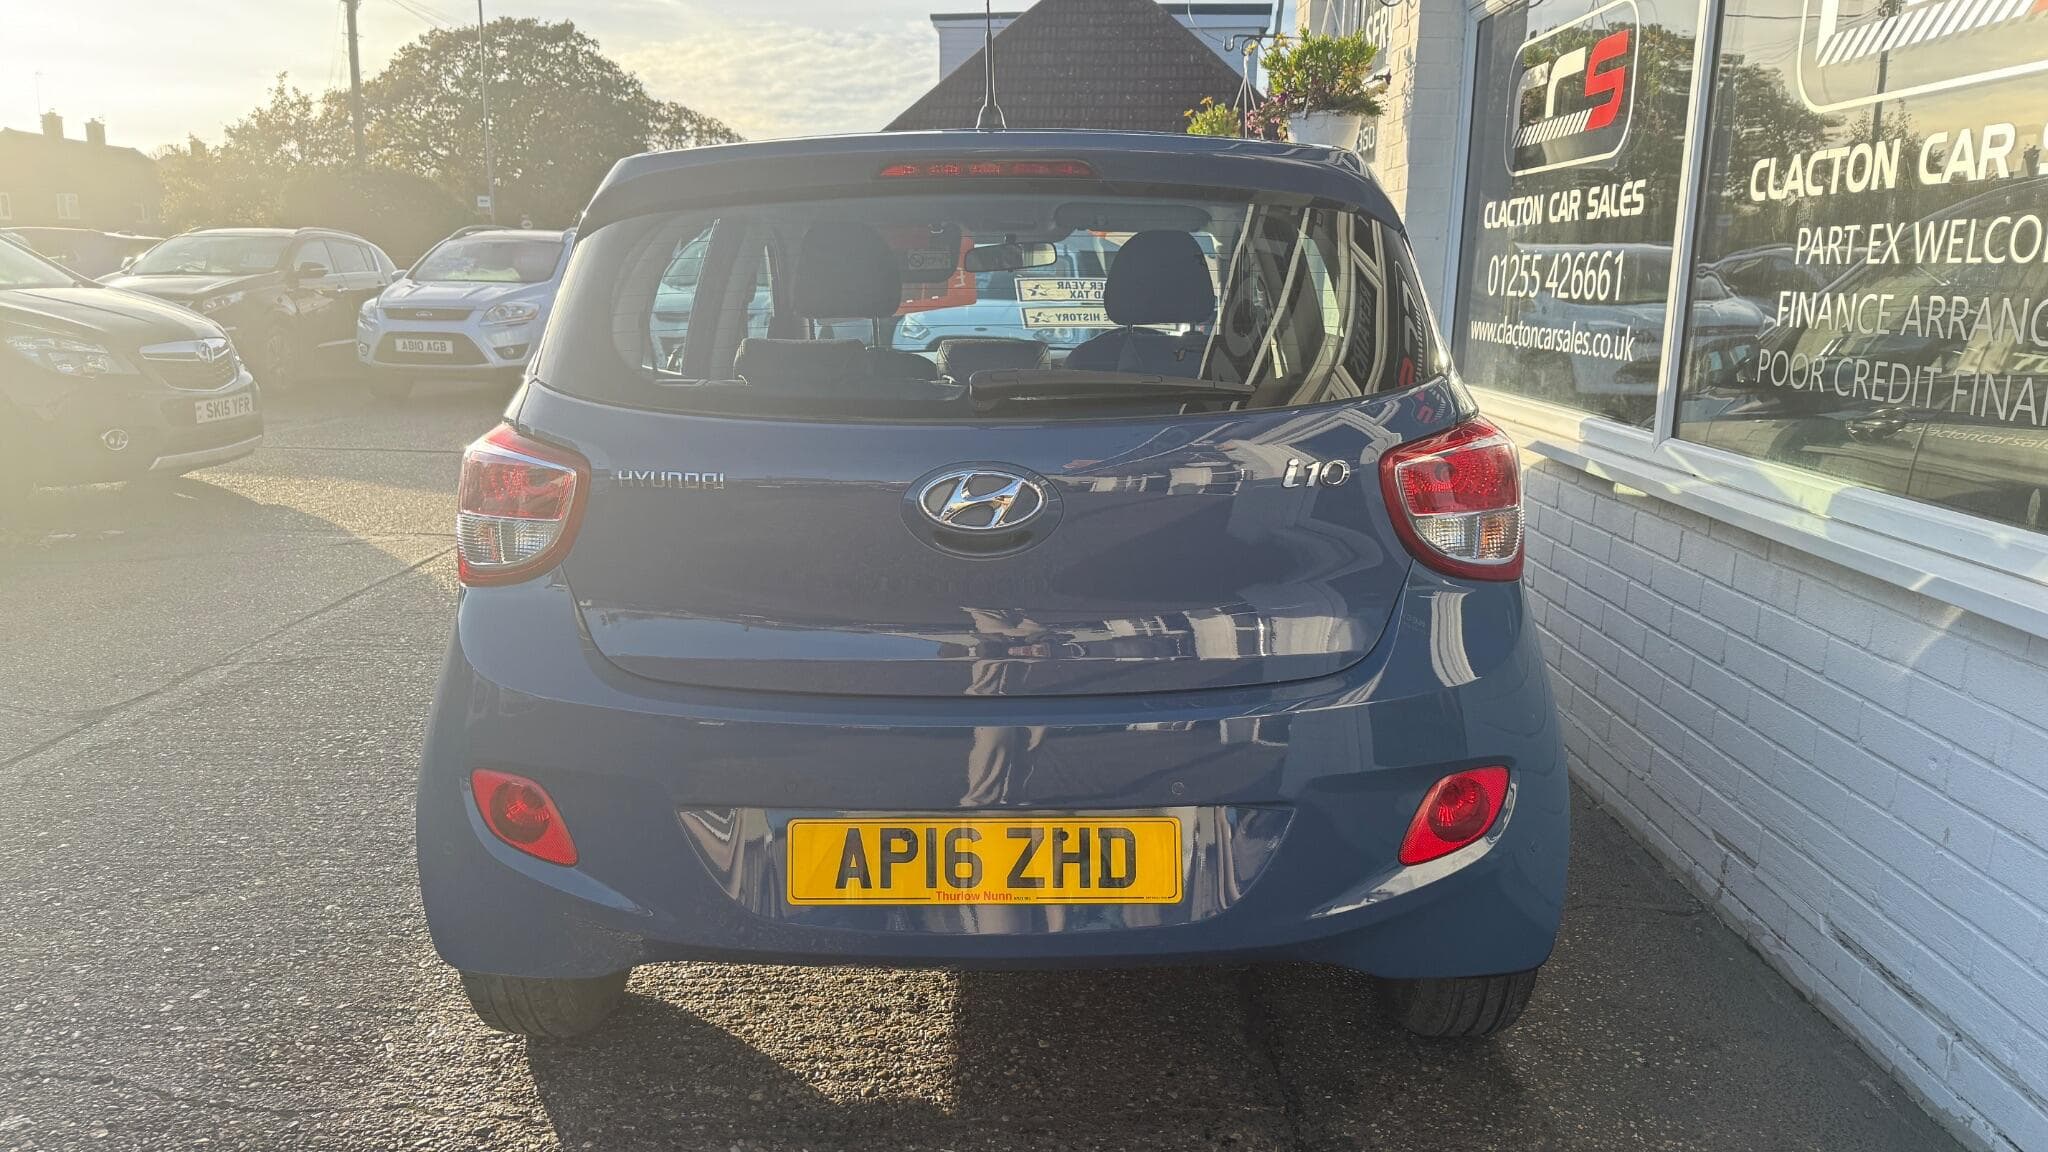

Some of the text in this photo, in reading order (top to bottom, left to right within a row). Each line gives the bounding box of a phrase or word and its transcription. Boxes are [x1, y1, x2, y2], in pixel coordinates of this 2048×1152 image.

[1750, 138, 1901, 202] CLACTON
[1918, 122, 2016, 186] CAR
[1484, 179, 1647, 229] CLACTON CAR SALES
[1795, 214, 2048, 265] PART EX WELCO
[1487, 250, 1625, 301] 01255 426661
[1776, 290, 1894, 335] FINANCE
[402, 340, 447, 352] AB10 AGB
[1471, 316, 1636, 362] www.clactoncarsales.co.uk
[206, 399, 231, 418] SK15
[1757, 348, 2048, 427] POOR CREDIT FINA
[618, 470, 725, 490] HYUNDAI
[1282, 458, 1351, 488] i10
[834, 827, 1137, 890] AP16 ZHD
[936, 891, 980, 901] Thurlow
[983, 891, 1012, 901] Nunn
